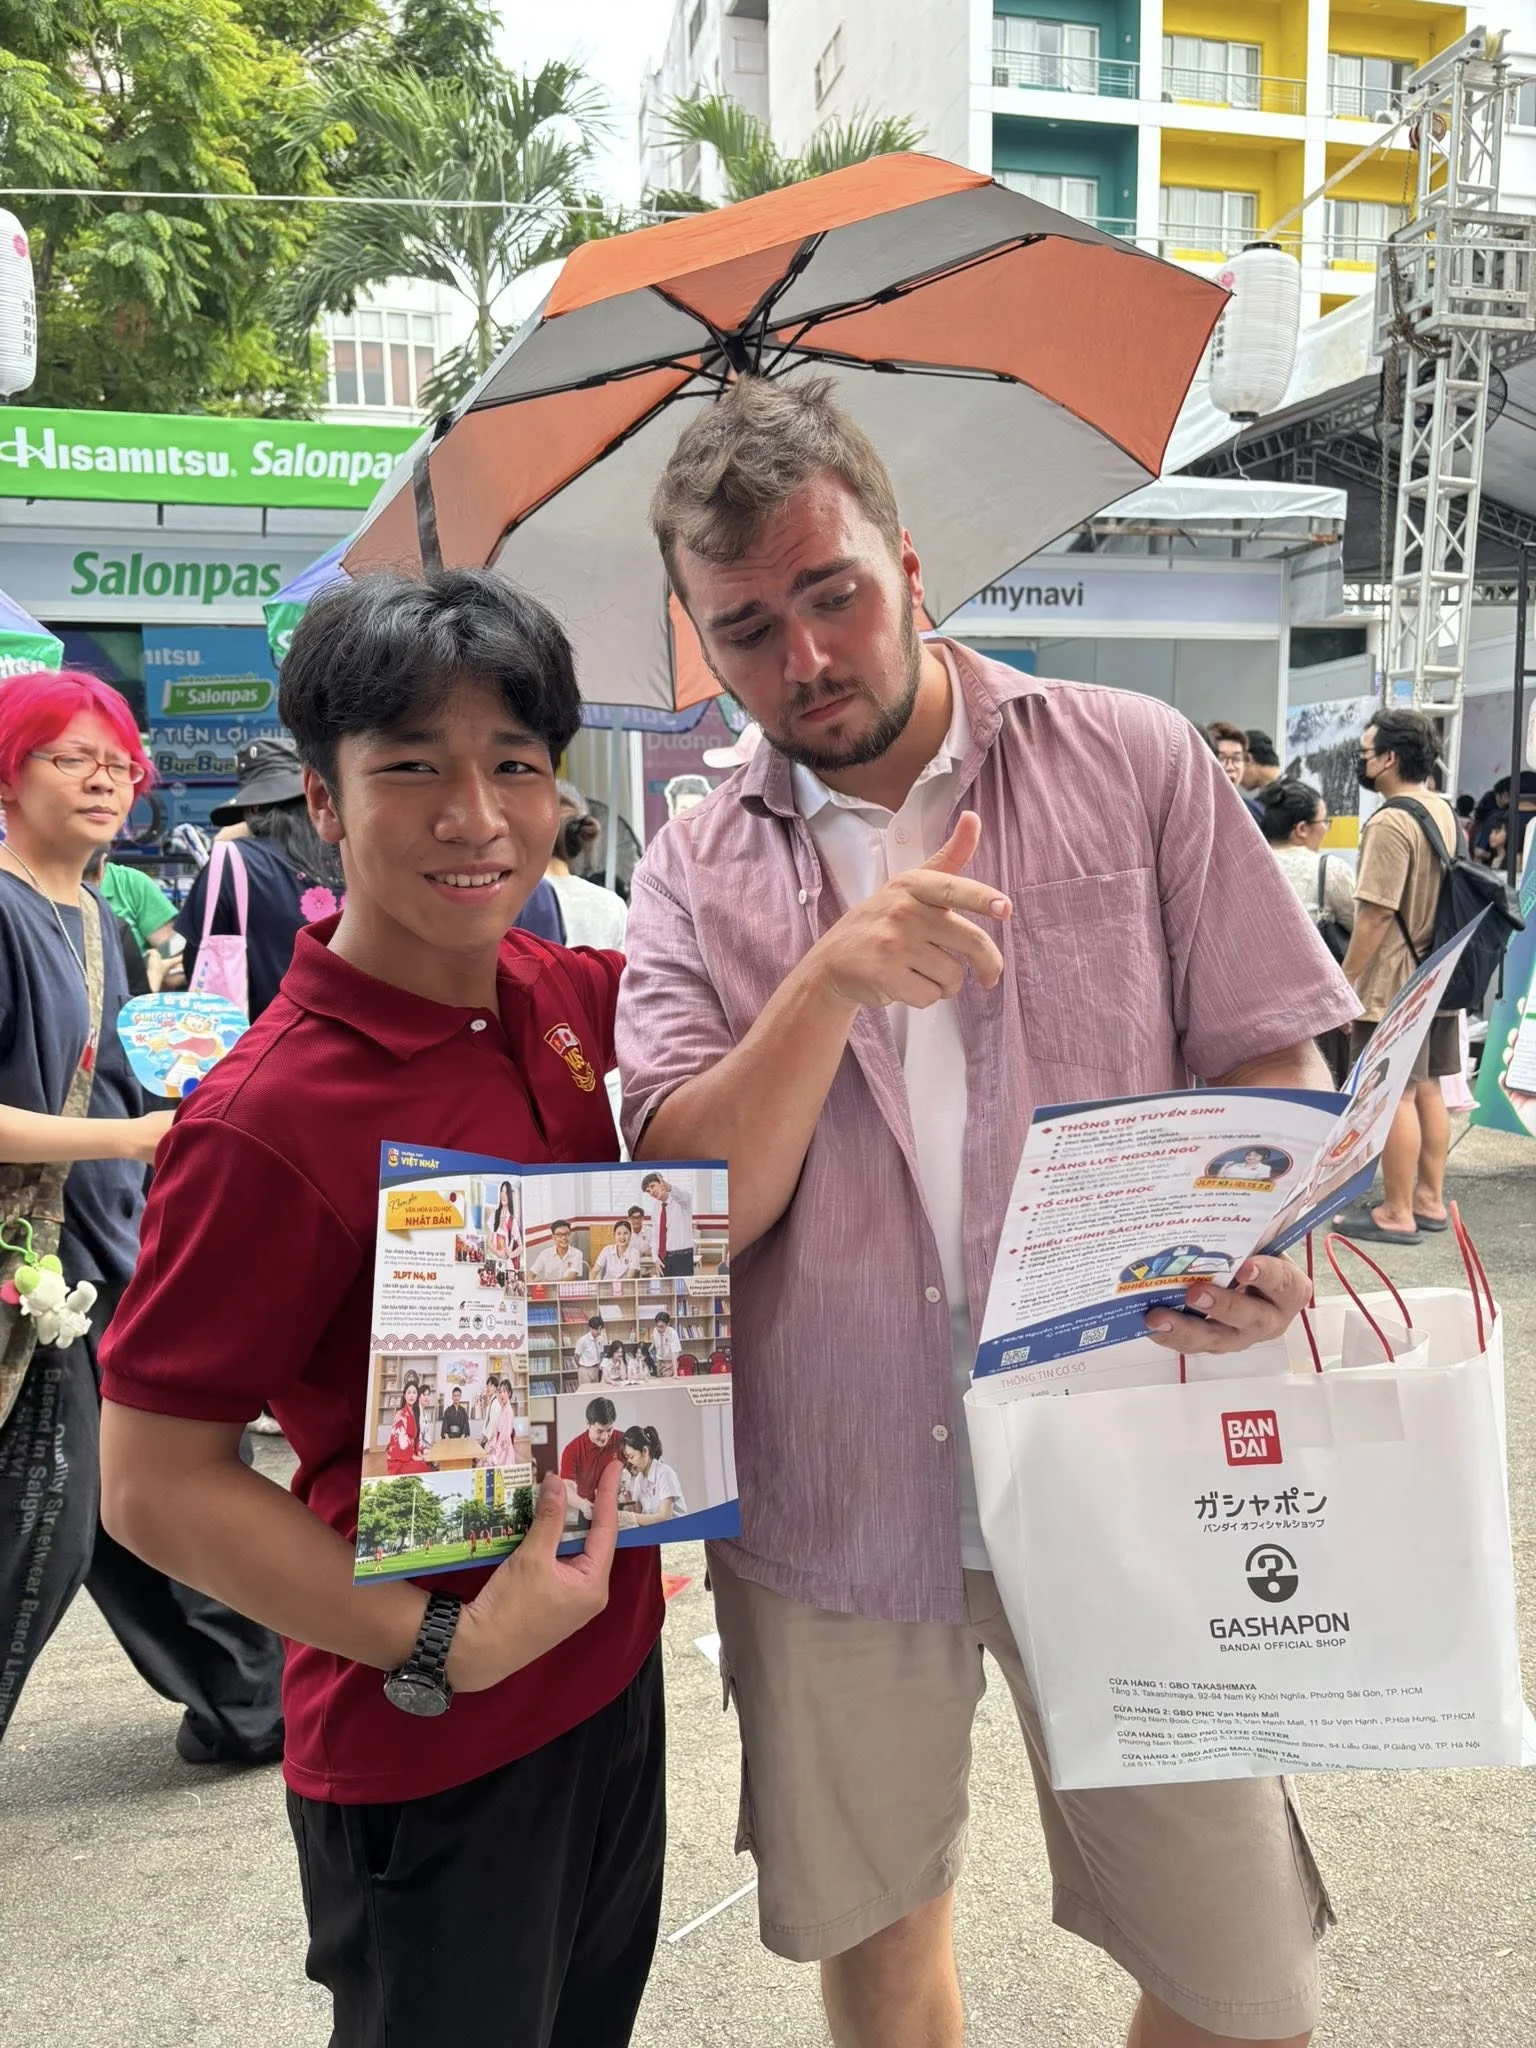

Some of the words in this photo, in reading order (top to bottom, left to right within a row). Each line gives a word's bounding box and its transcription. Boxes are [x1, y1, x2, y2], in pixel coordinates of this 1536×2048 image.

[7, 427, 230, 477] Hisamitsu
[71, 551, 281, 604] Salonpas
[981, 582, 1084, 611] mynavi
[187, 688, 258, 706] Salonpas
[165, 723, 209, 748] TIỆN
[1059, 1119, 1110, 1132] THÔNG
[1114, 1115, 1137, 1126] TIN
[1140, 1107, 1188, 1122] TUYỂN
[1190, 1107, 1226, 1116] SINH
[1120, 1149, 1166, 1162] NGOẠI
[1035, 1197, 1057, 1209] TỔ
[1059, 1192, 1094, 1206] CHỨC
[1097, 1187, 1124, 1200] LỚP
[1126, 1185, 1157, 1195] HỌC
[406, 1215, 431, 1227] NHẬT
[433, 1213, 451, 1224] BẢN
[1065, 1230, 1105, 1244] CHÍNH
[1107, 1225, 1145, 1238] SÁCH
[1192, 1214, 1220, 1226] HẤP
[393, 1271, 412, 1280] JLPT
[427, 1272, 437, 1280] N3
[1001, 1372, 1035, 1388] THÔNG
[1038, 1368, 1054, 1379] TIN
[1056, 1364, 1070, 1376] CƠ
[1072, 1361, 1087, 1372] SỞ
[1227, 1417, 1274, 1440] BAN
[31, 1432, 46, 1459] in
[1230, 1438, 1268, 1458] DAI
[20, 1465, 47, 1536] Saigon
[1194, 1487, 1327, 1520] ガシャポン
[1203, 1521, 1237, 1533] バンダイ
[1241, 1519, 1325, 1531] オフィシャルショップ
[25, 1496, 63, 1597] Streetwear
[15, 1598, 40, 1652] Brand
[1210, 1612, 1350, 1639] GASHAPON
[1220, 1642, 1261, 1653] BANDAI
[1264, 1639, 1313, 1651] OFFICIAL
[1316, 1638, 1346, 1648] SHOP
[1109, 1677, 1130, 1687] CỬA
[1131, 1680, 1156, 1688] HÀNG
[1169, 1682, 1189, 1690] GBO
[1192, 1682, 1256, 1691] TAKASHIMAYA
[1198, 1692, 1221, 1700] 92-94
[1259, 1692, 1278, 1700] Khởi
[1310, 1691, 1344, 1701] Phường
[1346, 1690, 1361, 1698] Sài
[1363, 1689, 1384, 1698] Gòn,
[1385, 1688, 1399, 1696] TP.
[1401, 1687, 1423, 1695] HCM
[1113, 1704, 1133, 1713] CỬA
[1135, 1706, 1161, 1715] HÀNG
[1173, 1709, 1194, 1717] GBO
[1195, 1710, 1215, 1718] PNC
[1217, 1711, 1234, 1719] Vạn
[1236, 1711, 1259, 1719] Hạnh
[1114, 1714, 1146, 1723] Phương
[1336, 1719, 1353, 1727] Vạn
[1355, 1718, 1377, 1726] Hạnh
[1440, 1713, 1475, 1721] TP.HCM
[1139, 1731, 1165, 1739] HÀNG
[1252, 1730, 1289, 1739] CENTER
[1451, 1741, 1463, 1749] Hà
[1466, 1741, 1480, 1749] Nội
[1202, 1746, 1227, 1754] AEON
[1281, 1751, 1300, 1759] TÂN
